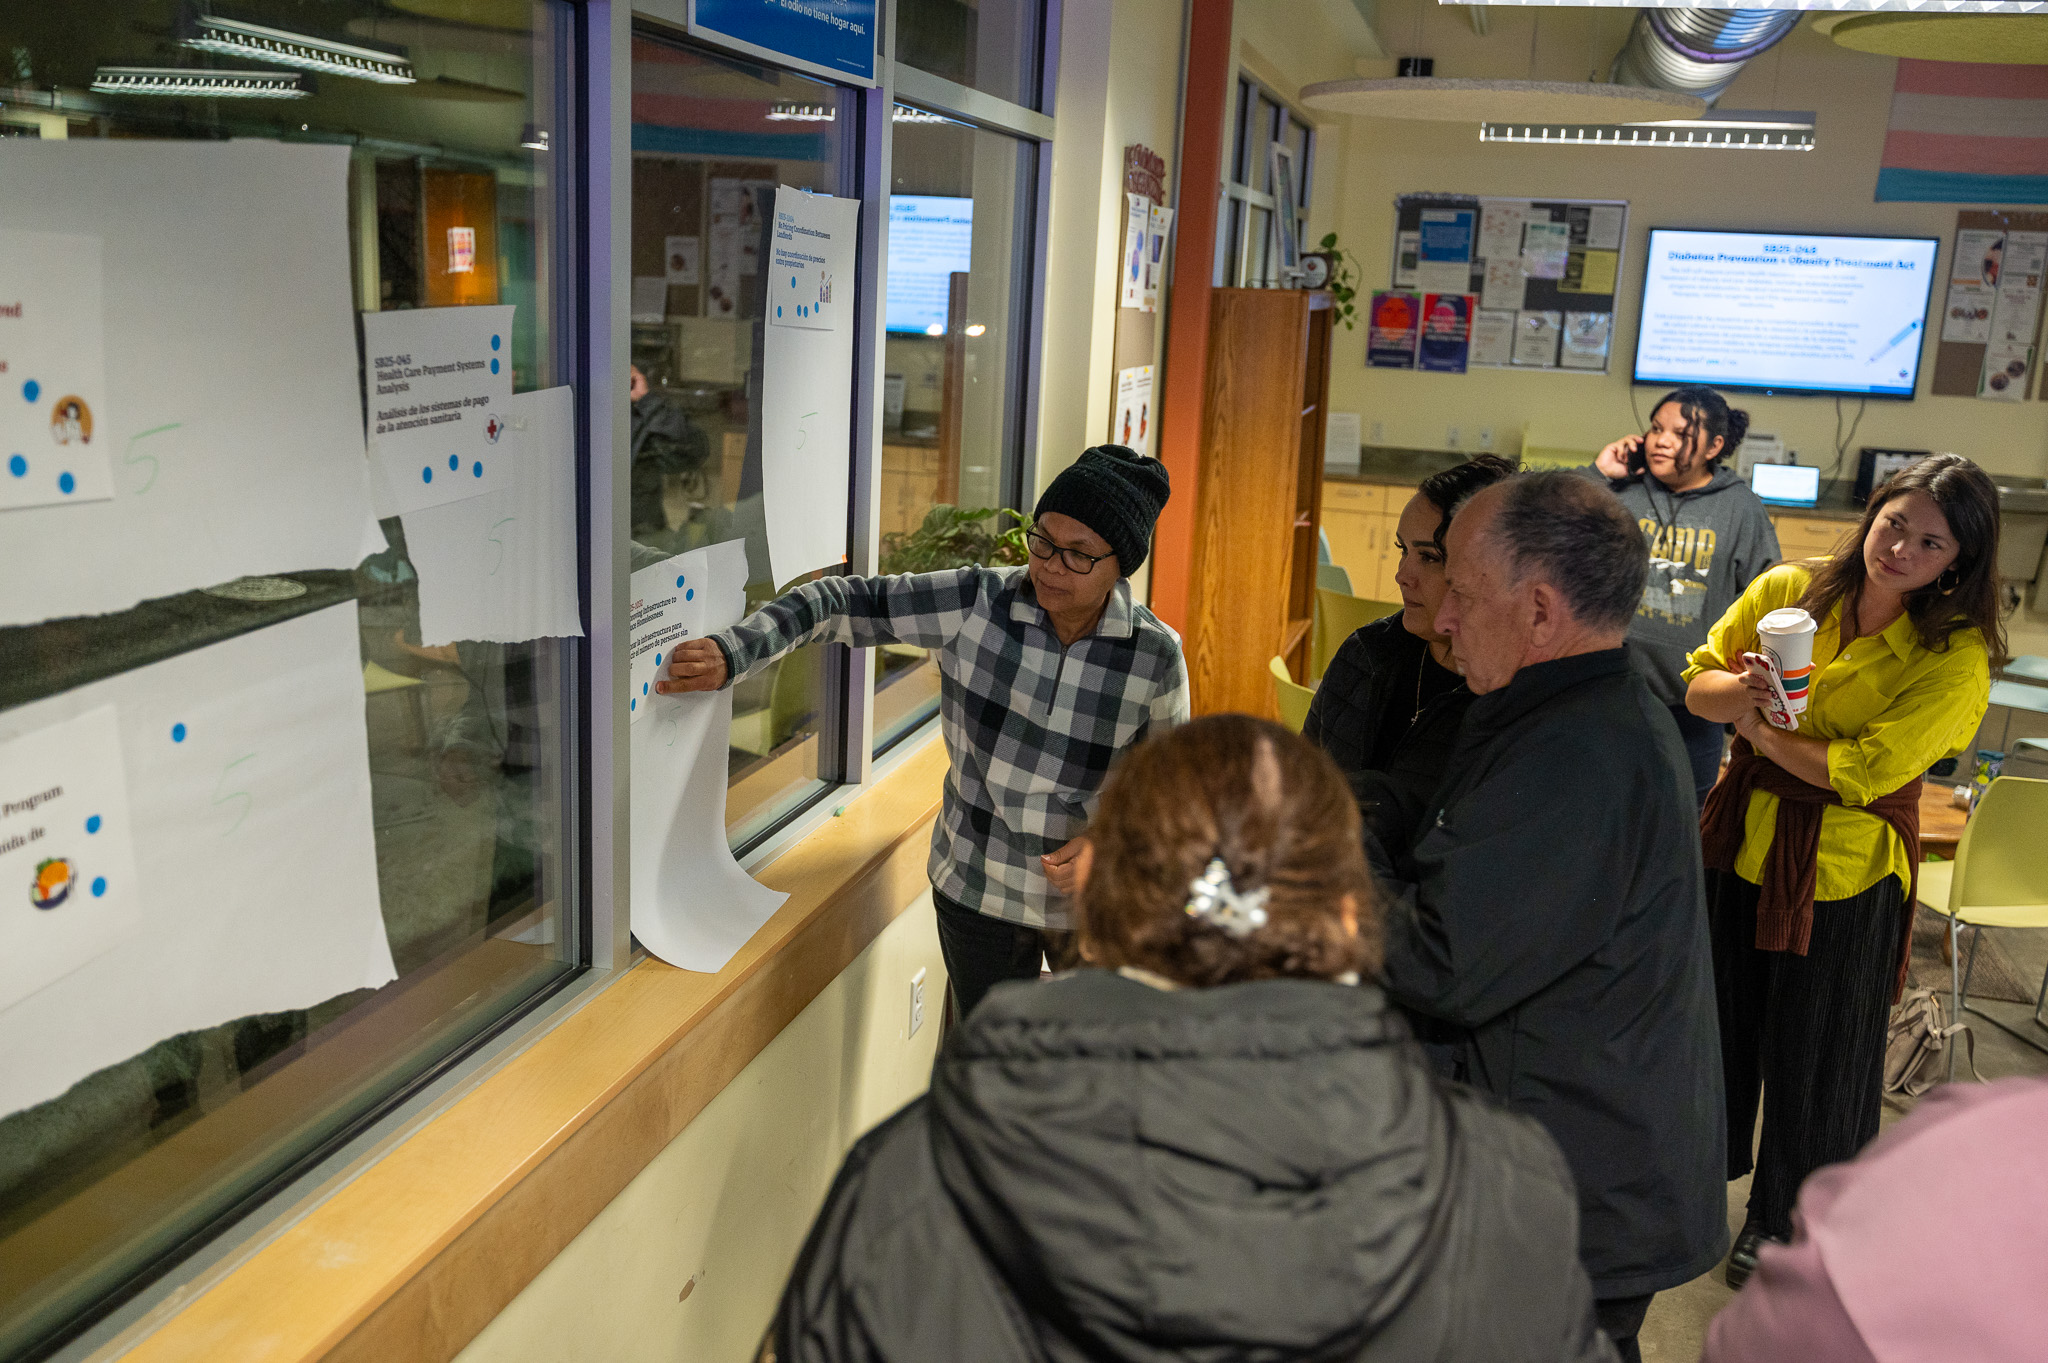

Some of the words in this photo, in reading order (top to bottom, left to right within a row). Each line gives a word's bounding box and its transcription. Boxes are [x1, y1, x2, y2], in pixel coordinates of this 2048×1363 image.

[788, 0, 803, 13] odio
[803, 7, 812, 16] no
[813, 7, 829, 23] tiene
[830, 11, 850, 30] hogar
[1668, 251, 1714, 262] Diabetes
[1717, 253, 1778, 264] Prevention
[1788, 255, 1831, 267] Obesity
[1833, 256, 1894, 270] Treatment
[1895, 259, 1916, 271] Act
[374, 354, 411, 369] SB25-045
[377, 368, 403, 381] Health
[404, 367, 421, 378] Care
[422, 363, 455, 377] Payment
[456, 360, 485, 373] Systems
[376, 381, 410, 395] Analysis
[377, 406, 407, 420] Análisis
[408, 405, 418, 415] de
[419, 403, 430, 414] los
[431, 399, 462, 411] sistemas
[463, 397, 472, 407] de
[472, 396, 489, 408] pago
[376, 423, 386, 434] de
[387, 422, 394, 432] la
[396, 417, 429, 430] atención
[430, 411, 462, 425] sanitaria
[796, 411, 818, 450] 5
[123, 422, 182, 496] 5
[487, 517, 515, 576] 5
[671, 596, 677, 604] to
[636, 610, 664, 627] Homelessness
[639, 641, 655, 655] número
[654, 638, 660, 647] de
[660, 631, 680, 646] personas
[680, 629, 688, 638] sin
[641, 626, 671, 645] infraestructura
[671, 622, 682, 633] para
[666, 705, 682, 747] 5
[2, 785, 64, 817] Program
[211, 752, 255, 838] 5
[28, 826, 46, 841] de
